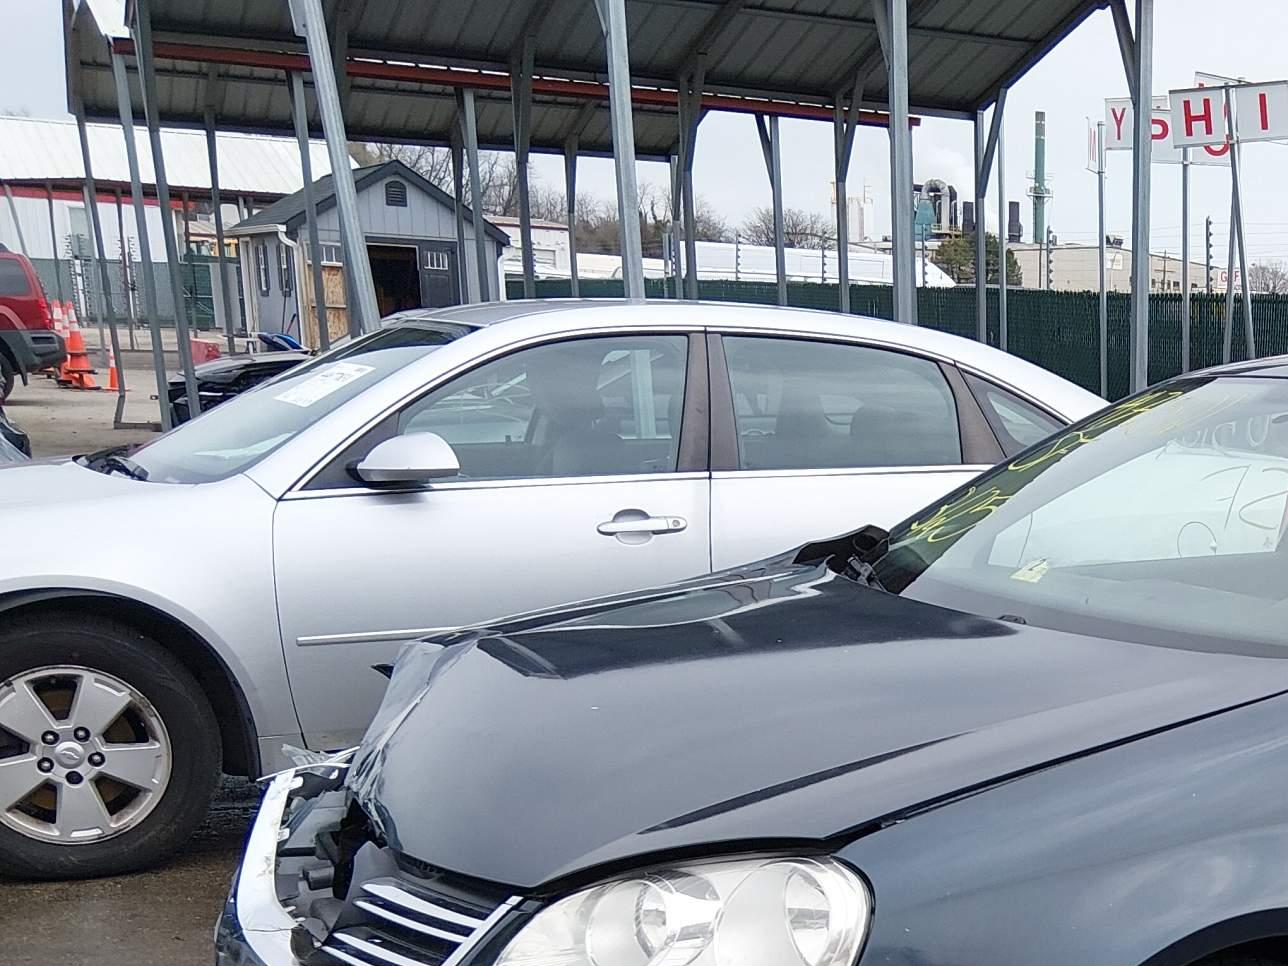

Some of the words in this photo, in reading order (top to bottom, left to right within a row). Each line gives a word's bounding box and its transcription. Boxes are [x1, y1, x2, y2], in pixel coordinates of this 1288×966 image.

[1110, 107, 1127, 141] Y
[1182, 98, 1213, 137] H
[1258, 92, 1269, 131] I
